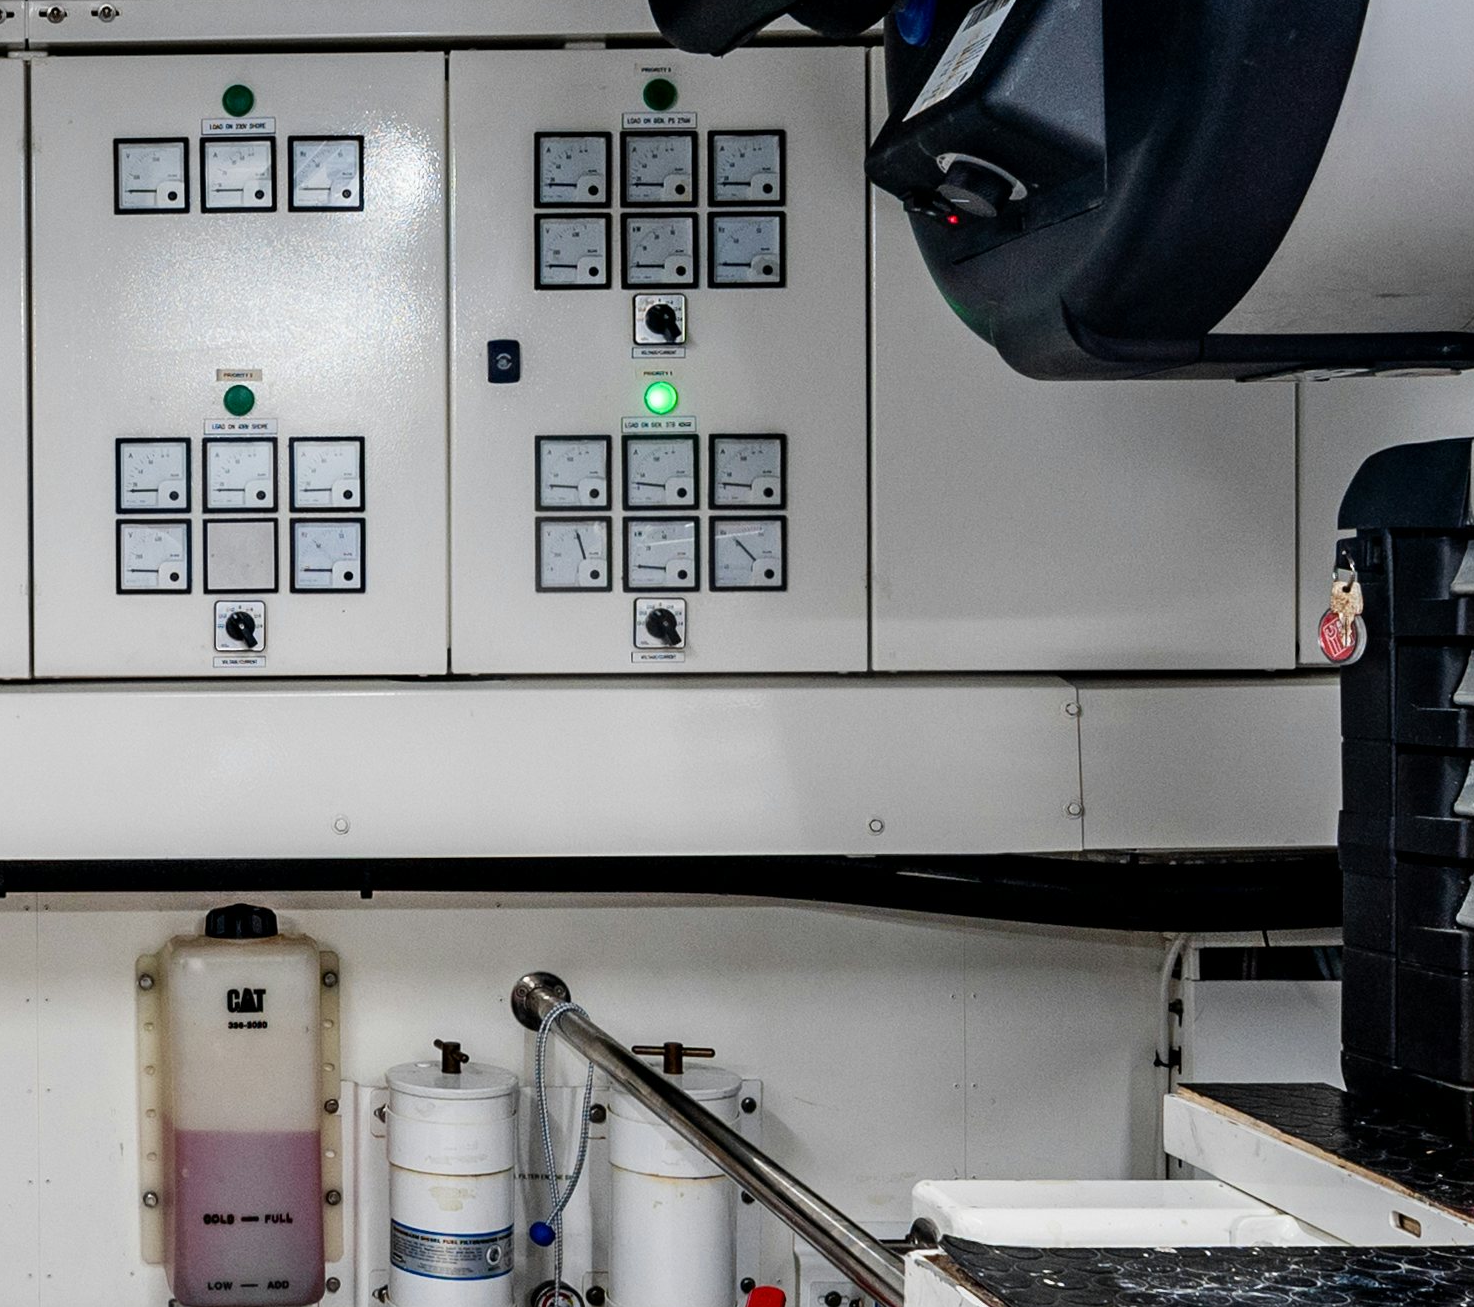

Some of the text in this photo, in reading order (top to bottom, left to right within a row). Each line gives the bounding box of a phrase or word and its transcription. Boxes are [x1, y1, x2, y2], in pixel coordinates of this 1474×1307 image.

[627, 117, 641, 125] LOAD
[209, 122, 223, 130] LOAD
[212, 422, 225, 430] LOAD
[226, 987, 267, 1013] CAT
[203, 1212, 293, 1225] COLD FULL
[207, 1280, 290, 1291] LOW ADD
